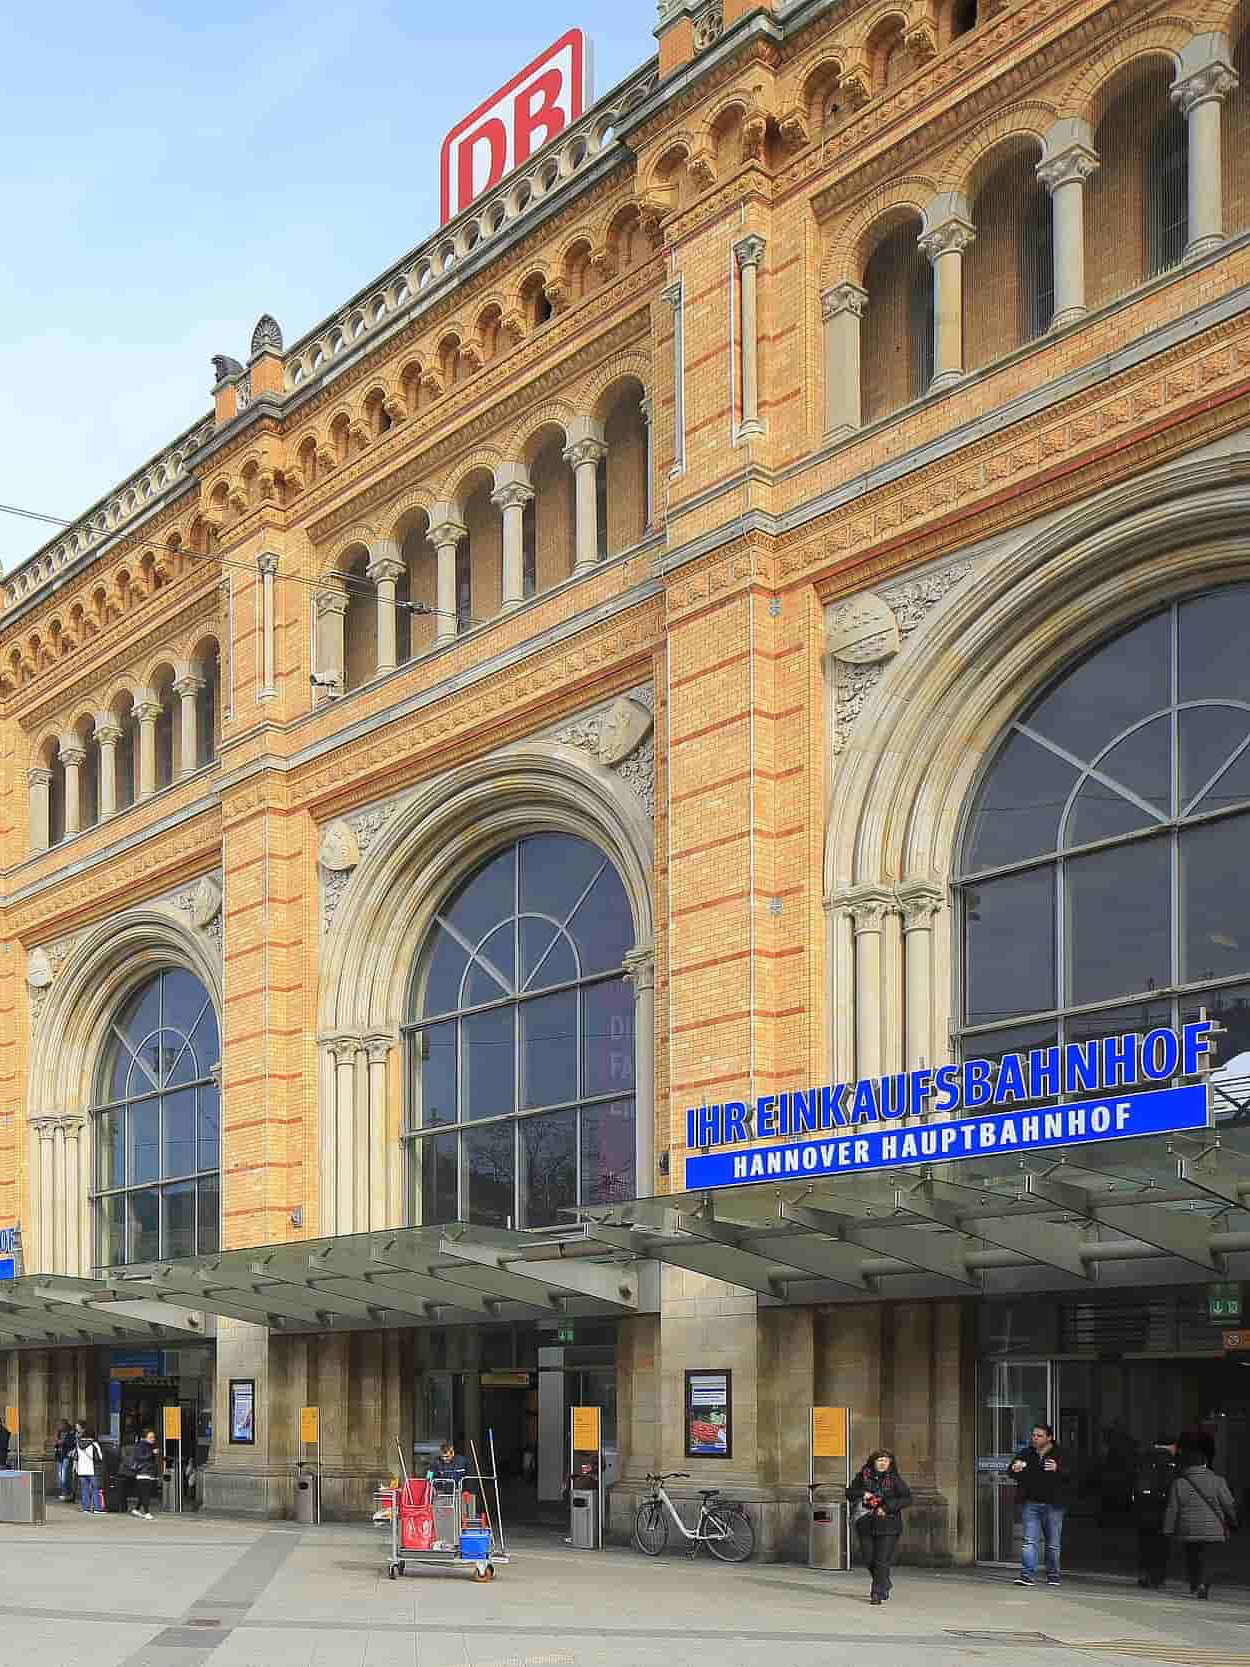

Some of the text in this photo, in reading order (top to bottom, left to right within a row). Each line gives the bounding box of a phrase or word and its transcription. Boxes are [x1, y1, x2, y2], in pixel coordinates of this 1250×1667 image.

[458, 68, 565, 211] DB
[686, 1020, 1215, 1149] IHR EINKAUFSBAHNHOF
[733, 1102, 1132, 1179] HANNOVER HAUPTBAHNHOF
